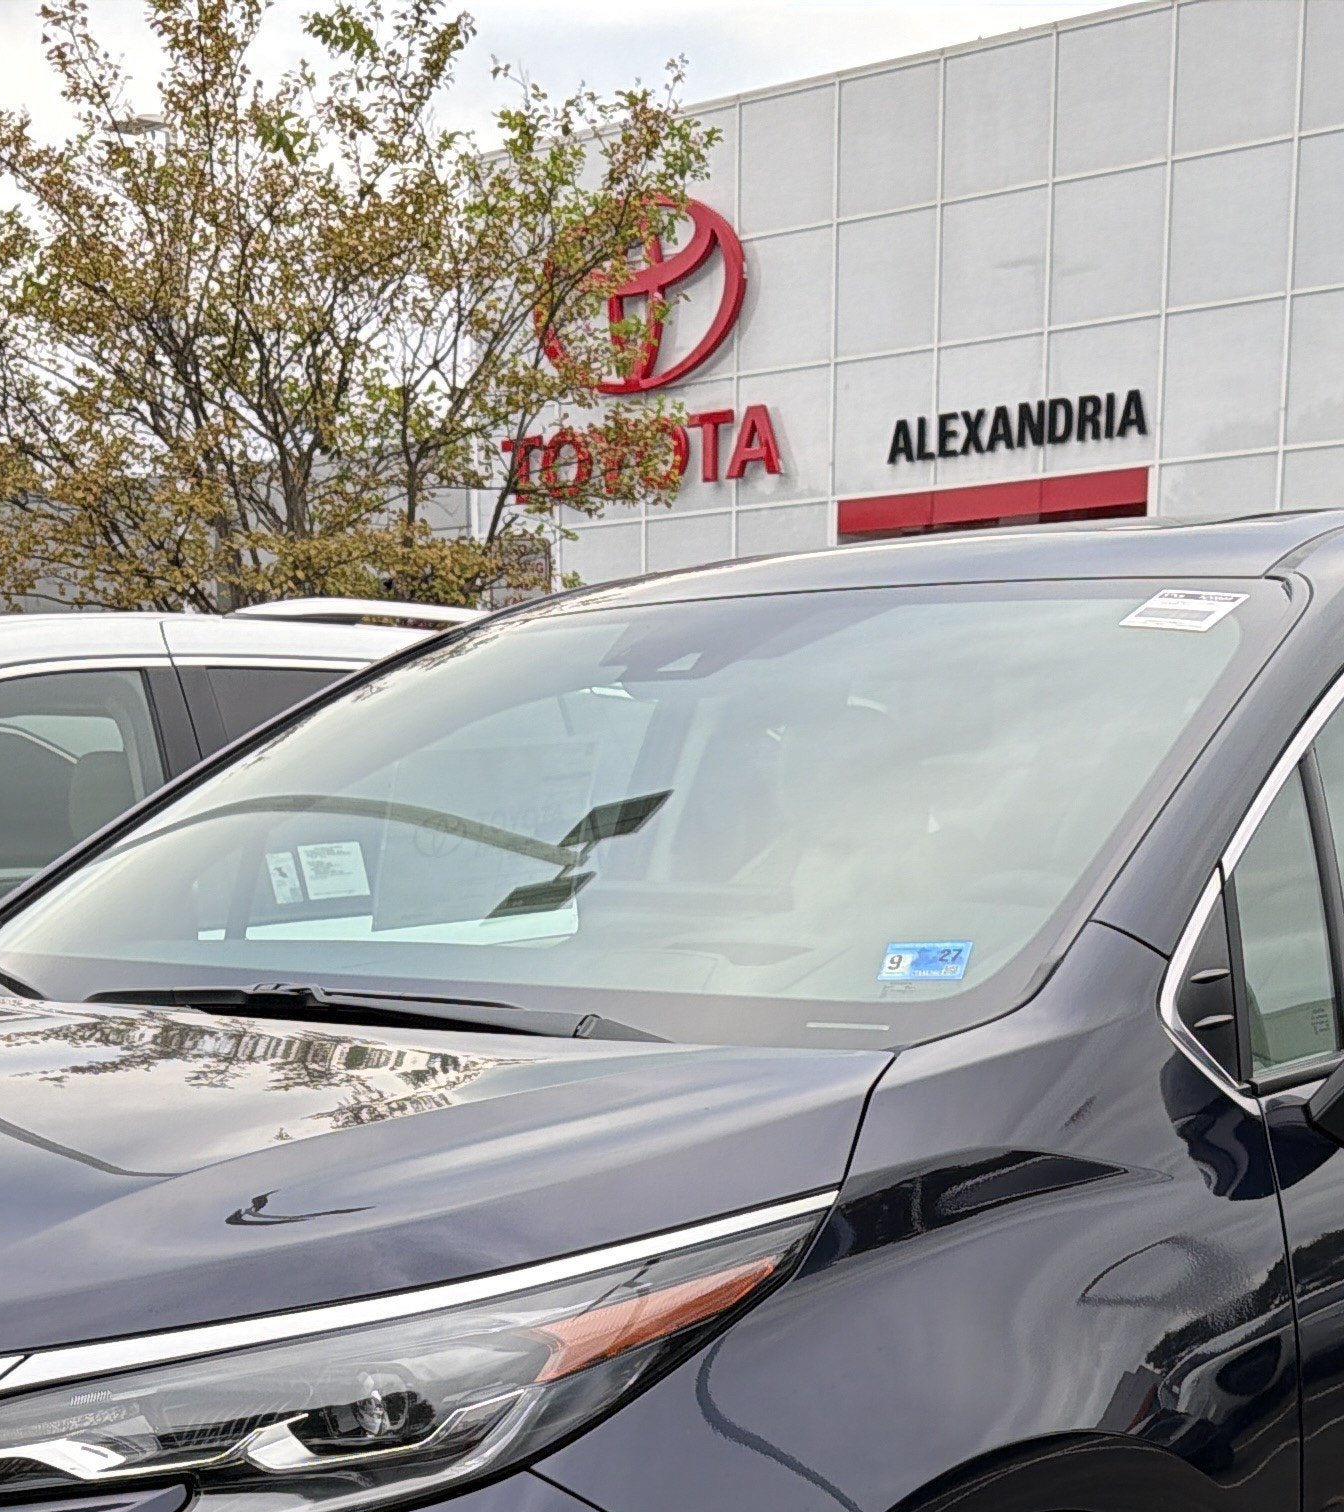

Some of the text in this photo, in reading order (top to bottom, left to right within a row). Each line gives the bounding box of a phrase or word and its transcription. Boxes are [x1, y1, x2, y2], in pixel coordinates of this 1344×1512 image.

[887, 389, 1148, 464] ALEXANDRIA
[887, 954, 903, 970] 9
[939, 948, 963, 962] 27
